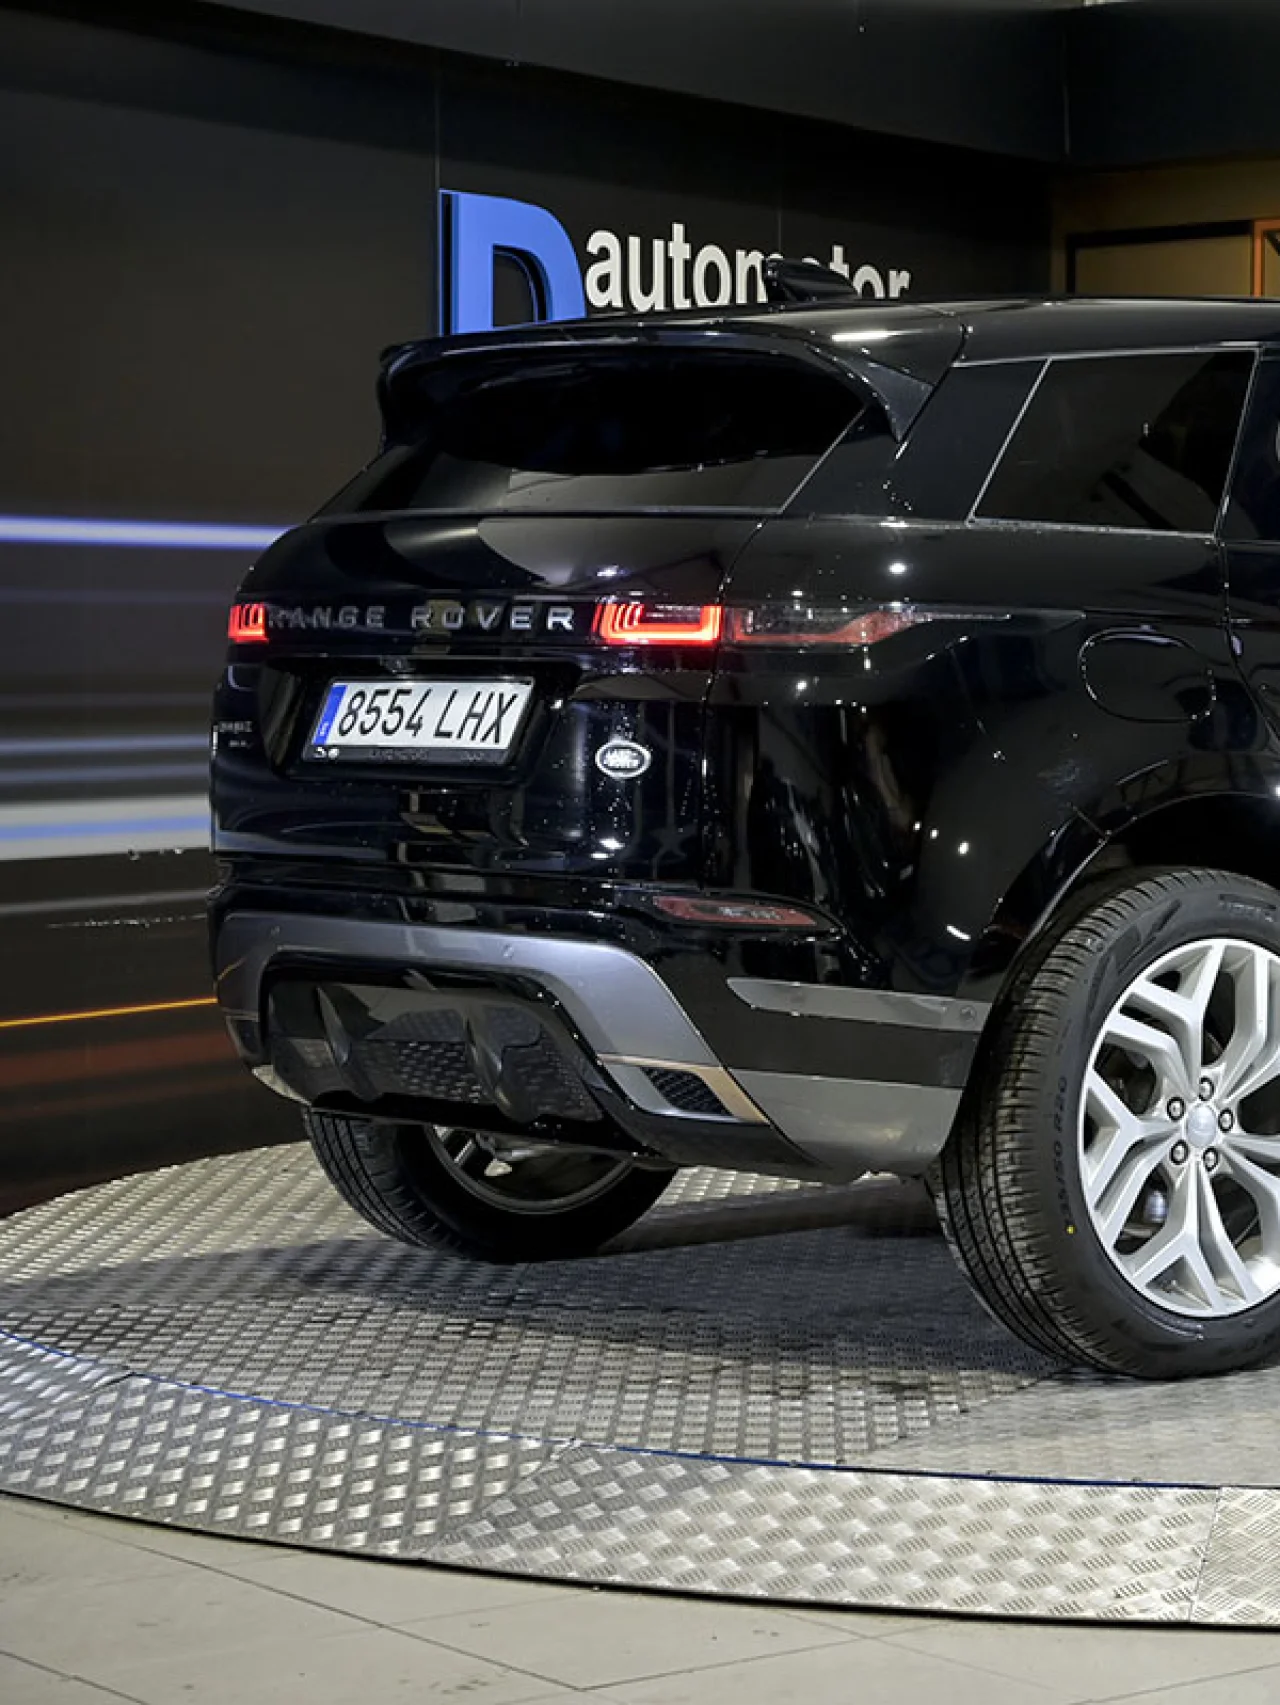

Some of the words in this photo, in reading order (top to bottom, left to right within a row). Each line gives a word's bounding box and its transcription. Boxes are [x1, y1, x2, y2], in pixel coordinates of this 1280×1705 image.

[411, 605, 575, 630] ROVER
[338, 688, 432, 737] 8554
[433, 689, 518, 744] LHX
